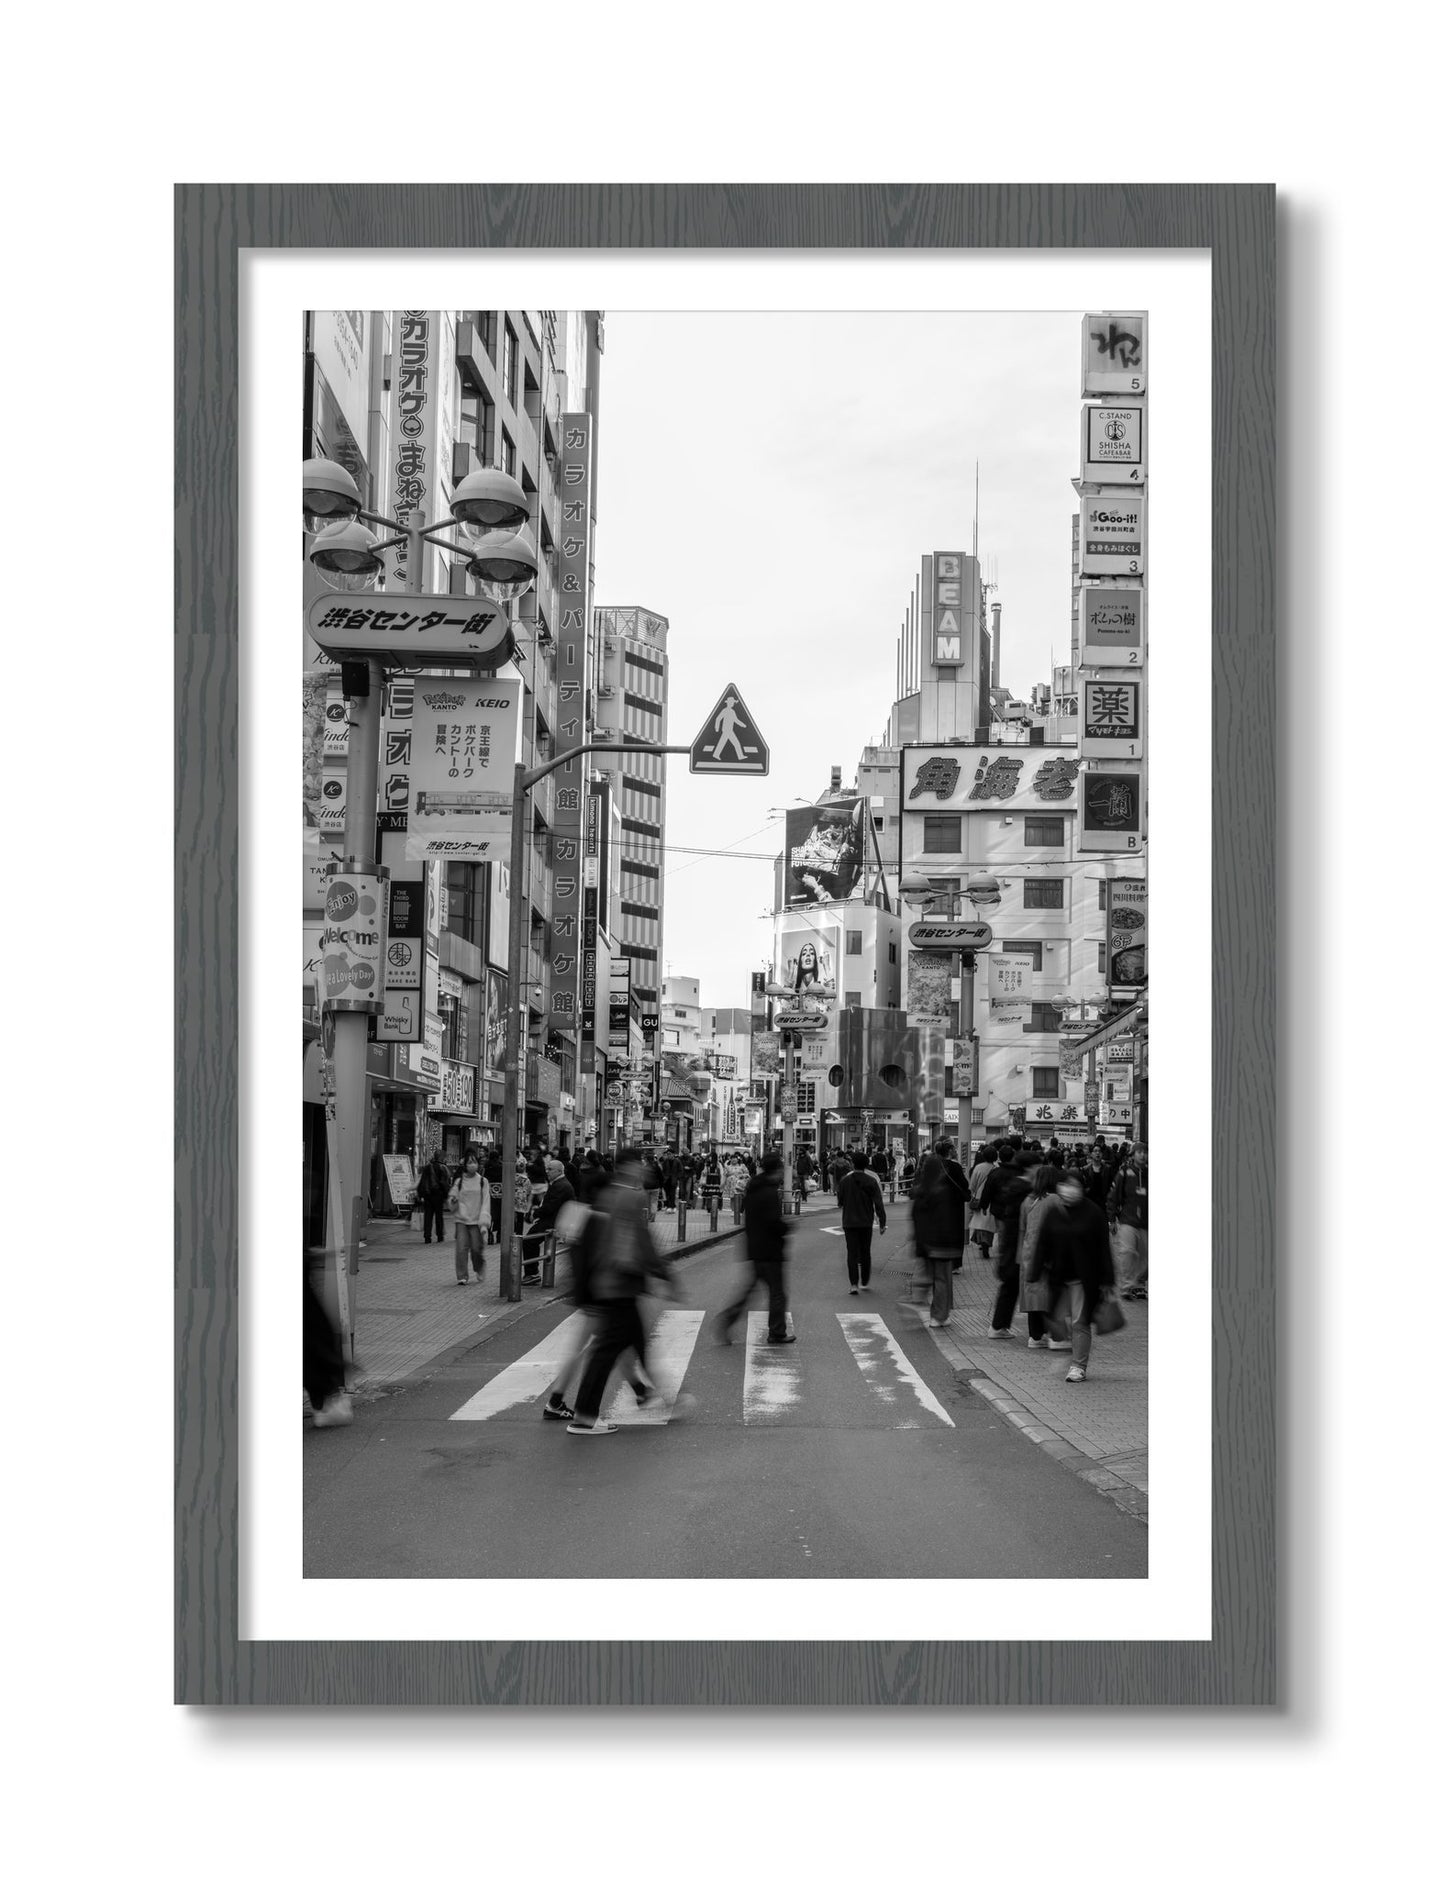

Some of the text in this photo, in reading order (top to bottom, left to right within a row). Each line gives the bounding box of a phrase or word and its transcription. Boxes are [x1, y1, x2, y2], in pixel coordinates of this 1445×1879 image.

[1131, 378, 1140, 390] 5
[1098, 441, 1132, 450] SHISHA
[1129, 468, 1140, 481] 4
[1097, 511, 1138, 523] Goo-it!
[1129, 560, 1138, 573] 3
[936, 555, 961, 660] BEAM
[318, 607, 497, 634] 渋谷センター街
[1129, 651, 1138, 664] 2
[475, 698, 510, 709] KEIO
[1093, 687, 1129, 723] 薬
[448, 725, 462, 778] カントーの
[1129, 744, 1135, 756] 1
[426, 841, 490, 851] 渋谷センター街
[1127, 836, 1136, 848] B
[327, 890, 356, 916] Enjoy
[324, 927, 379, 945] Welcome
[914, 928, 988, 938] 渋谷センター街
[383, 1022, 400, 1030] Bank
[385, 1016, 409, 1025] Whisky
[643, 1018, 658, 1027] GU
